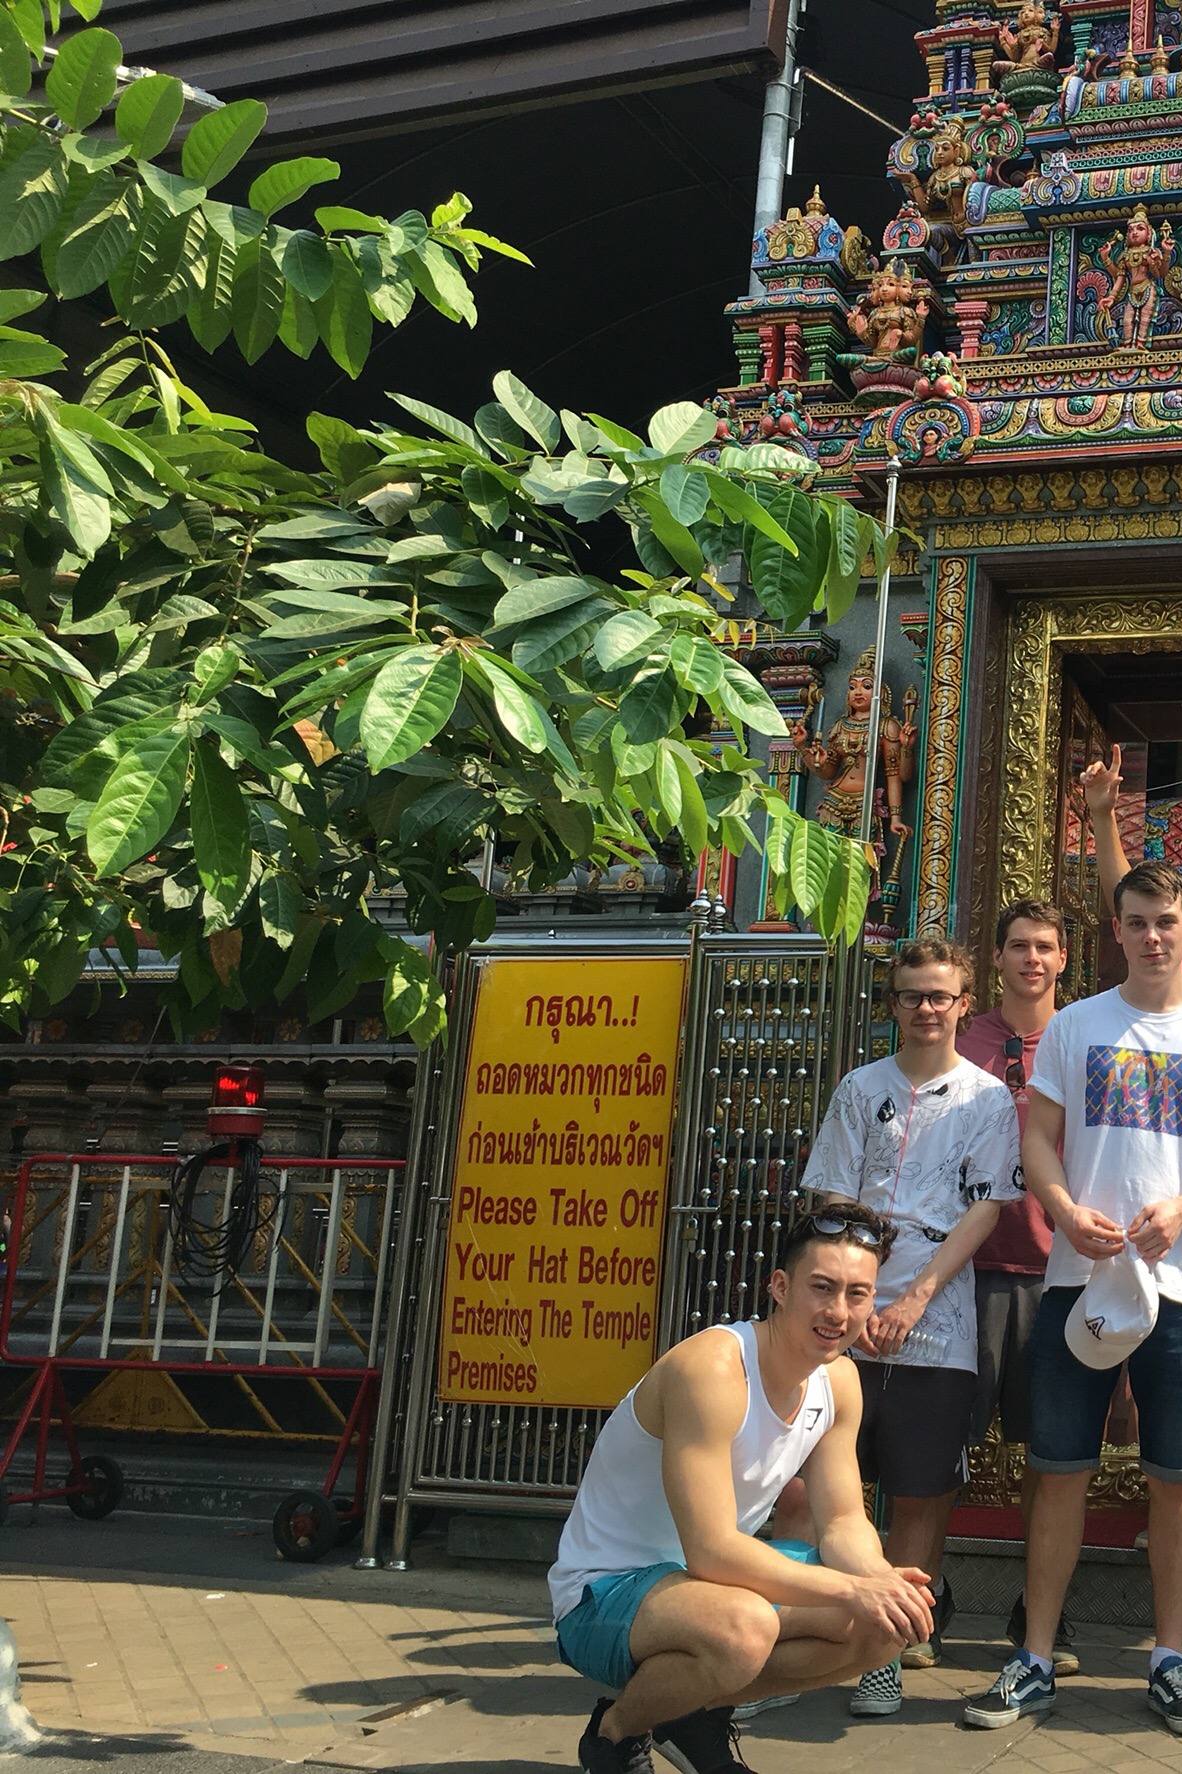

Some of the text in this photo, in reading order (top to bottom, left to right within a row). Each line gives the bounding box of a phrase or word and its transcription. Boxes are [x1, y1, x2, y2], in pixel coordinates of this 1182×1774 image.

[477, 1053, 666, 1113] ถอดหมวกทุกชนิด
[457, 1187, 658, 1227] Please Take Off
[455, 1243, 655, 1286] Your Hat Before
[452, 1297, 651, 1349] Entering The Temple
[448, 1351, 537, 1393] Premises
